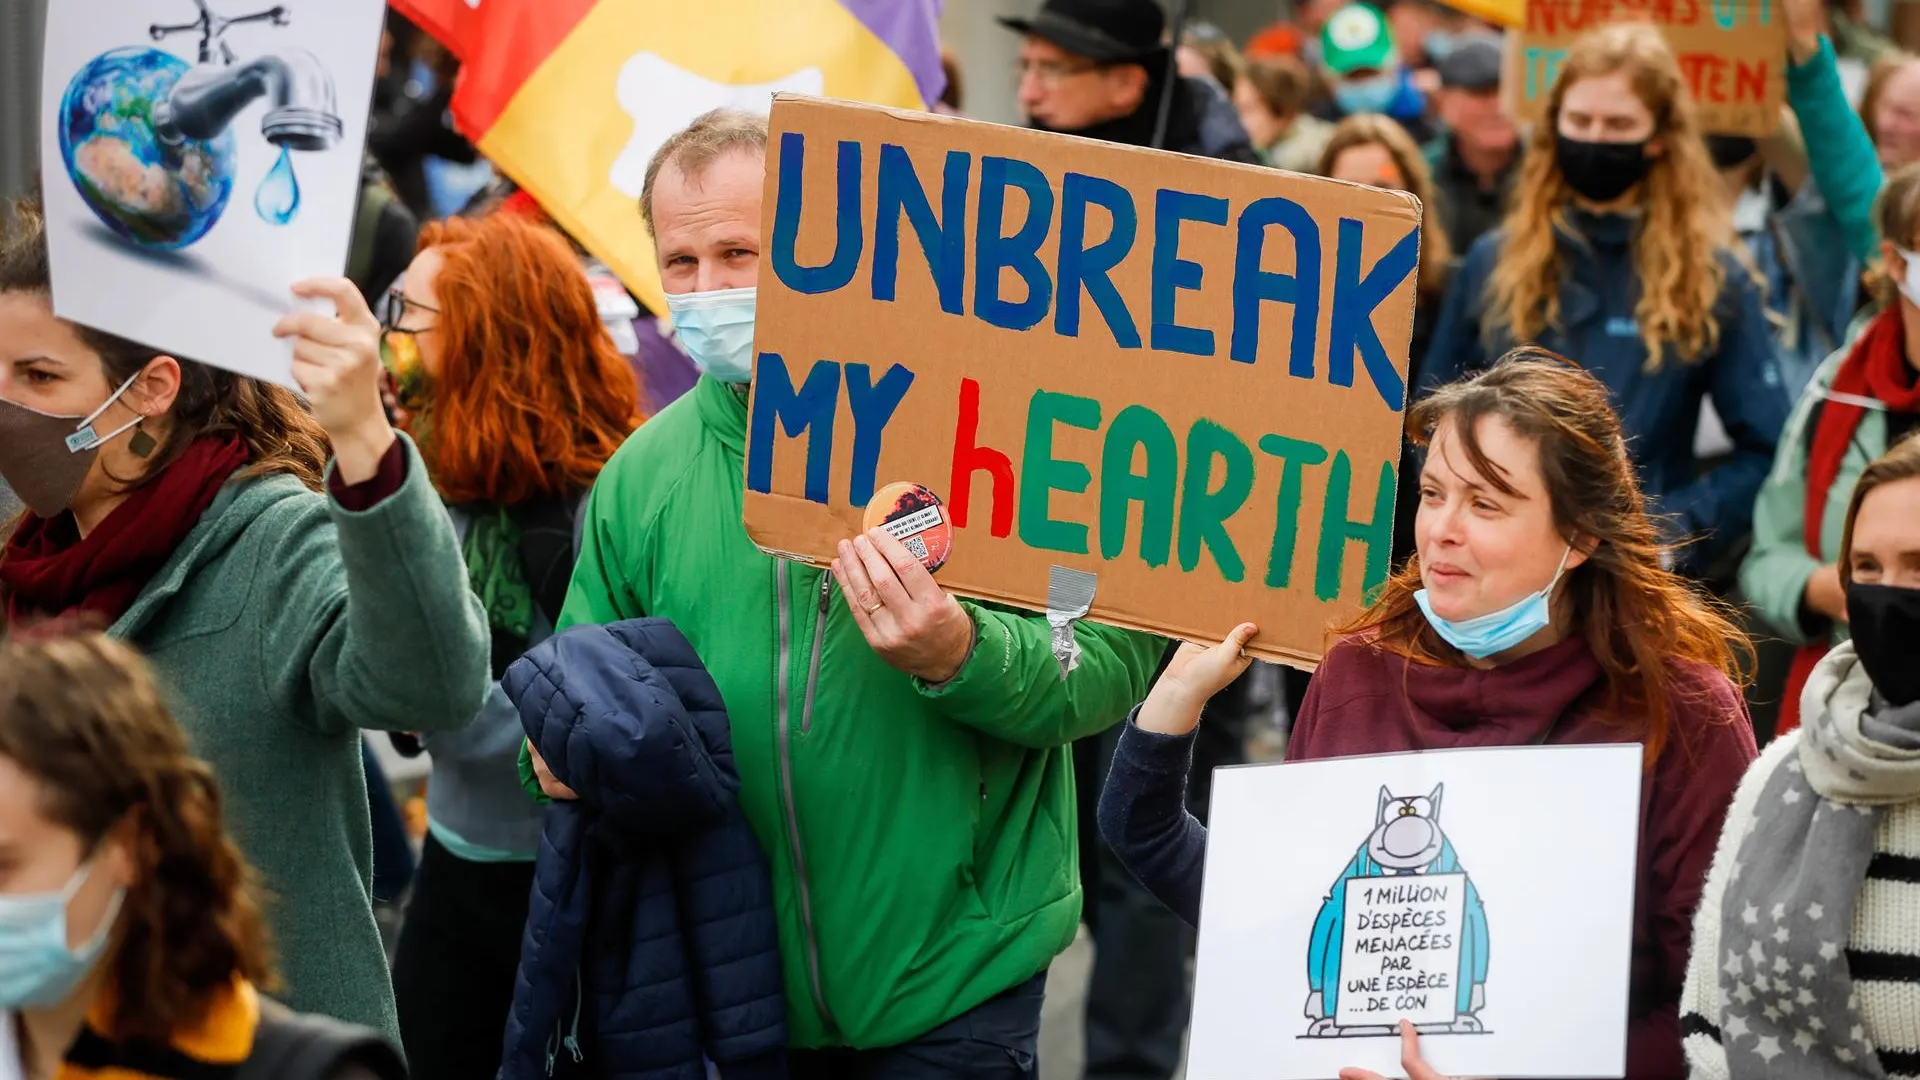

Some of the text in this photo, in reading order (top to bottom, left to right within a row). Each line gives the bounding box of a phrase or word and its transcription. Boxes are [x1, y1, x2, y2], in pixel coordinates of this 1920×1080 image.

[771, 132, 1420, 412] UNBREAK
[747, 352, 1397, 608] MY hEARTH
[1364, 887, 1373, 905] 1
[1357, 907, 1446, 934] D'ESPÈCES
[1355, 929, 1453, 954] MENACÉES
[1380, 955, 1412, 975] PAR
[1347, 970, 1450, 994] UNE ESPÈCE
[1395, 994, 1428, 1011] CON
